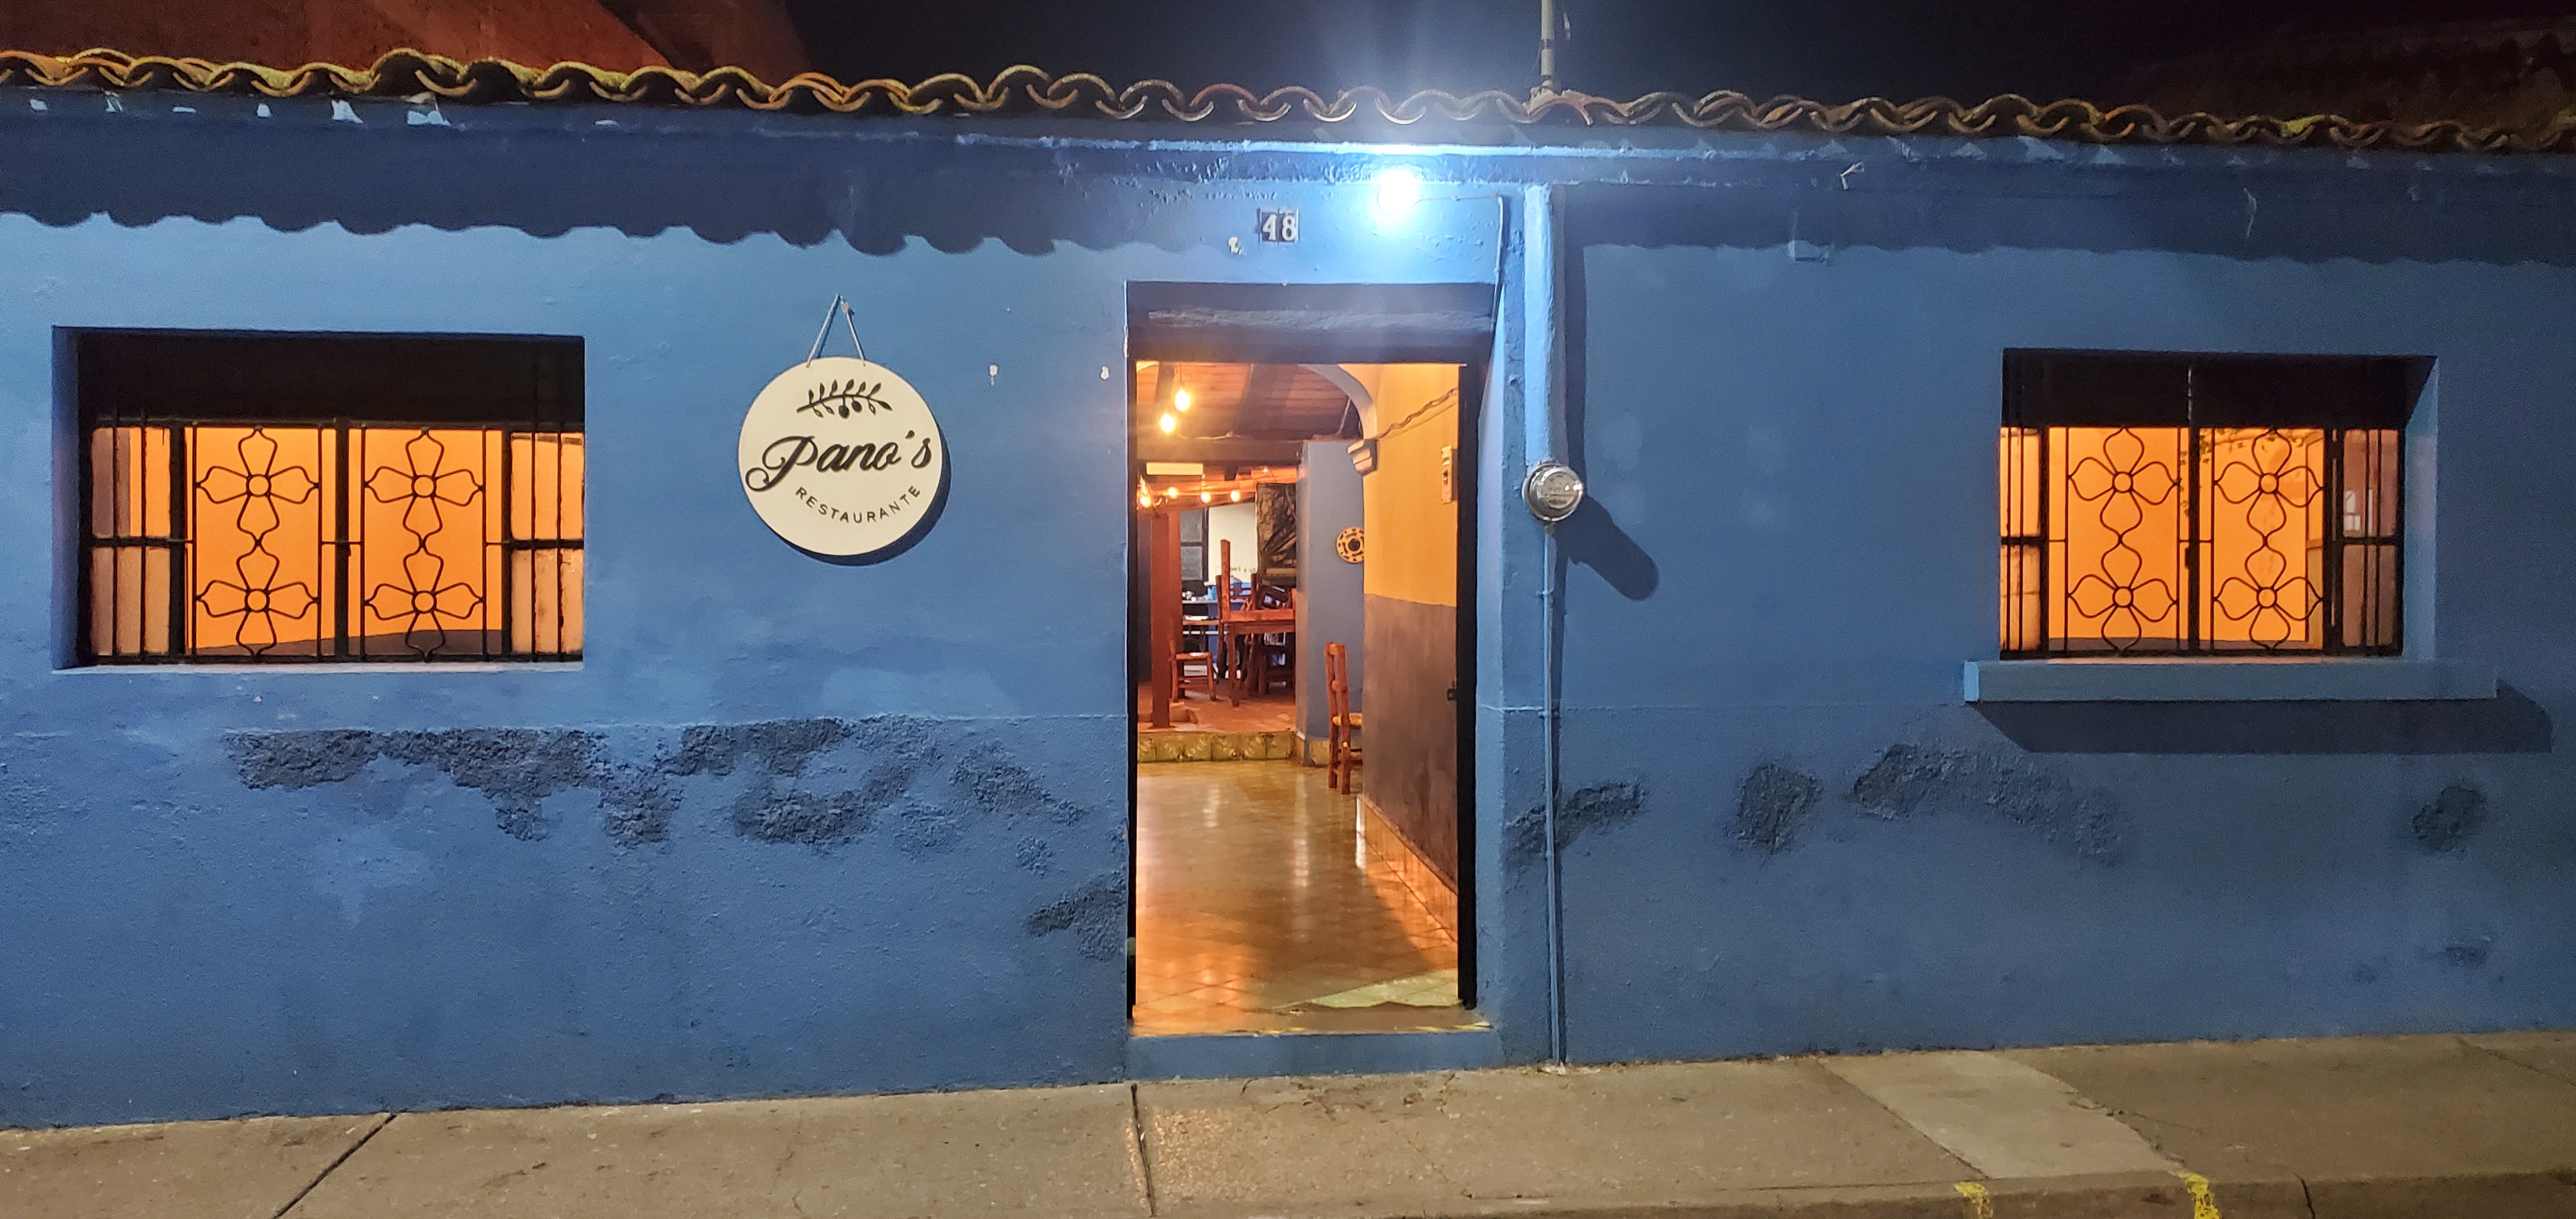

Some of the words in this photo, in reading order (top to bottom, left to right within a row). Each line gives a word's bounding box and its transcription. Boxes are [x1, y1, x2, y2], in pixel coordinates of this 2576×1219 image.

[1262, 213, 1297, 241] 48
[745, 429, 933, 492] Pano's
[795, 485, 921, 523] RESTAURANTE
